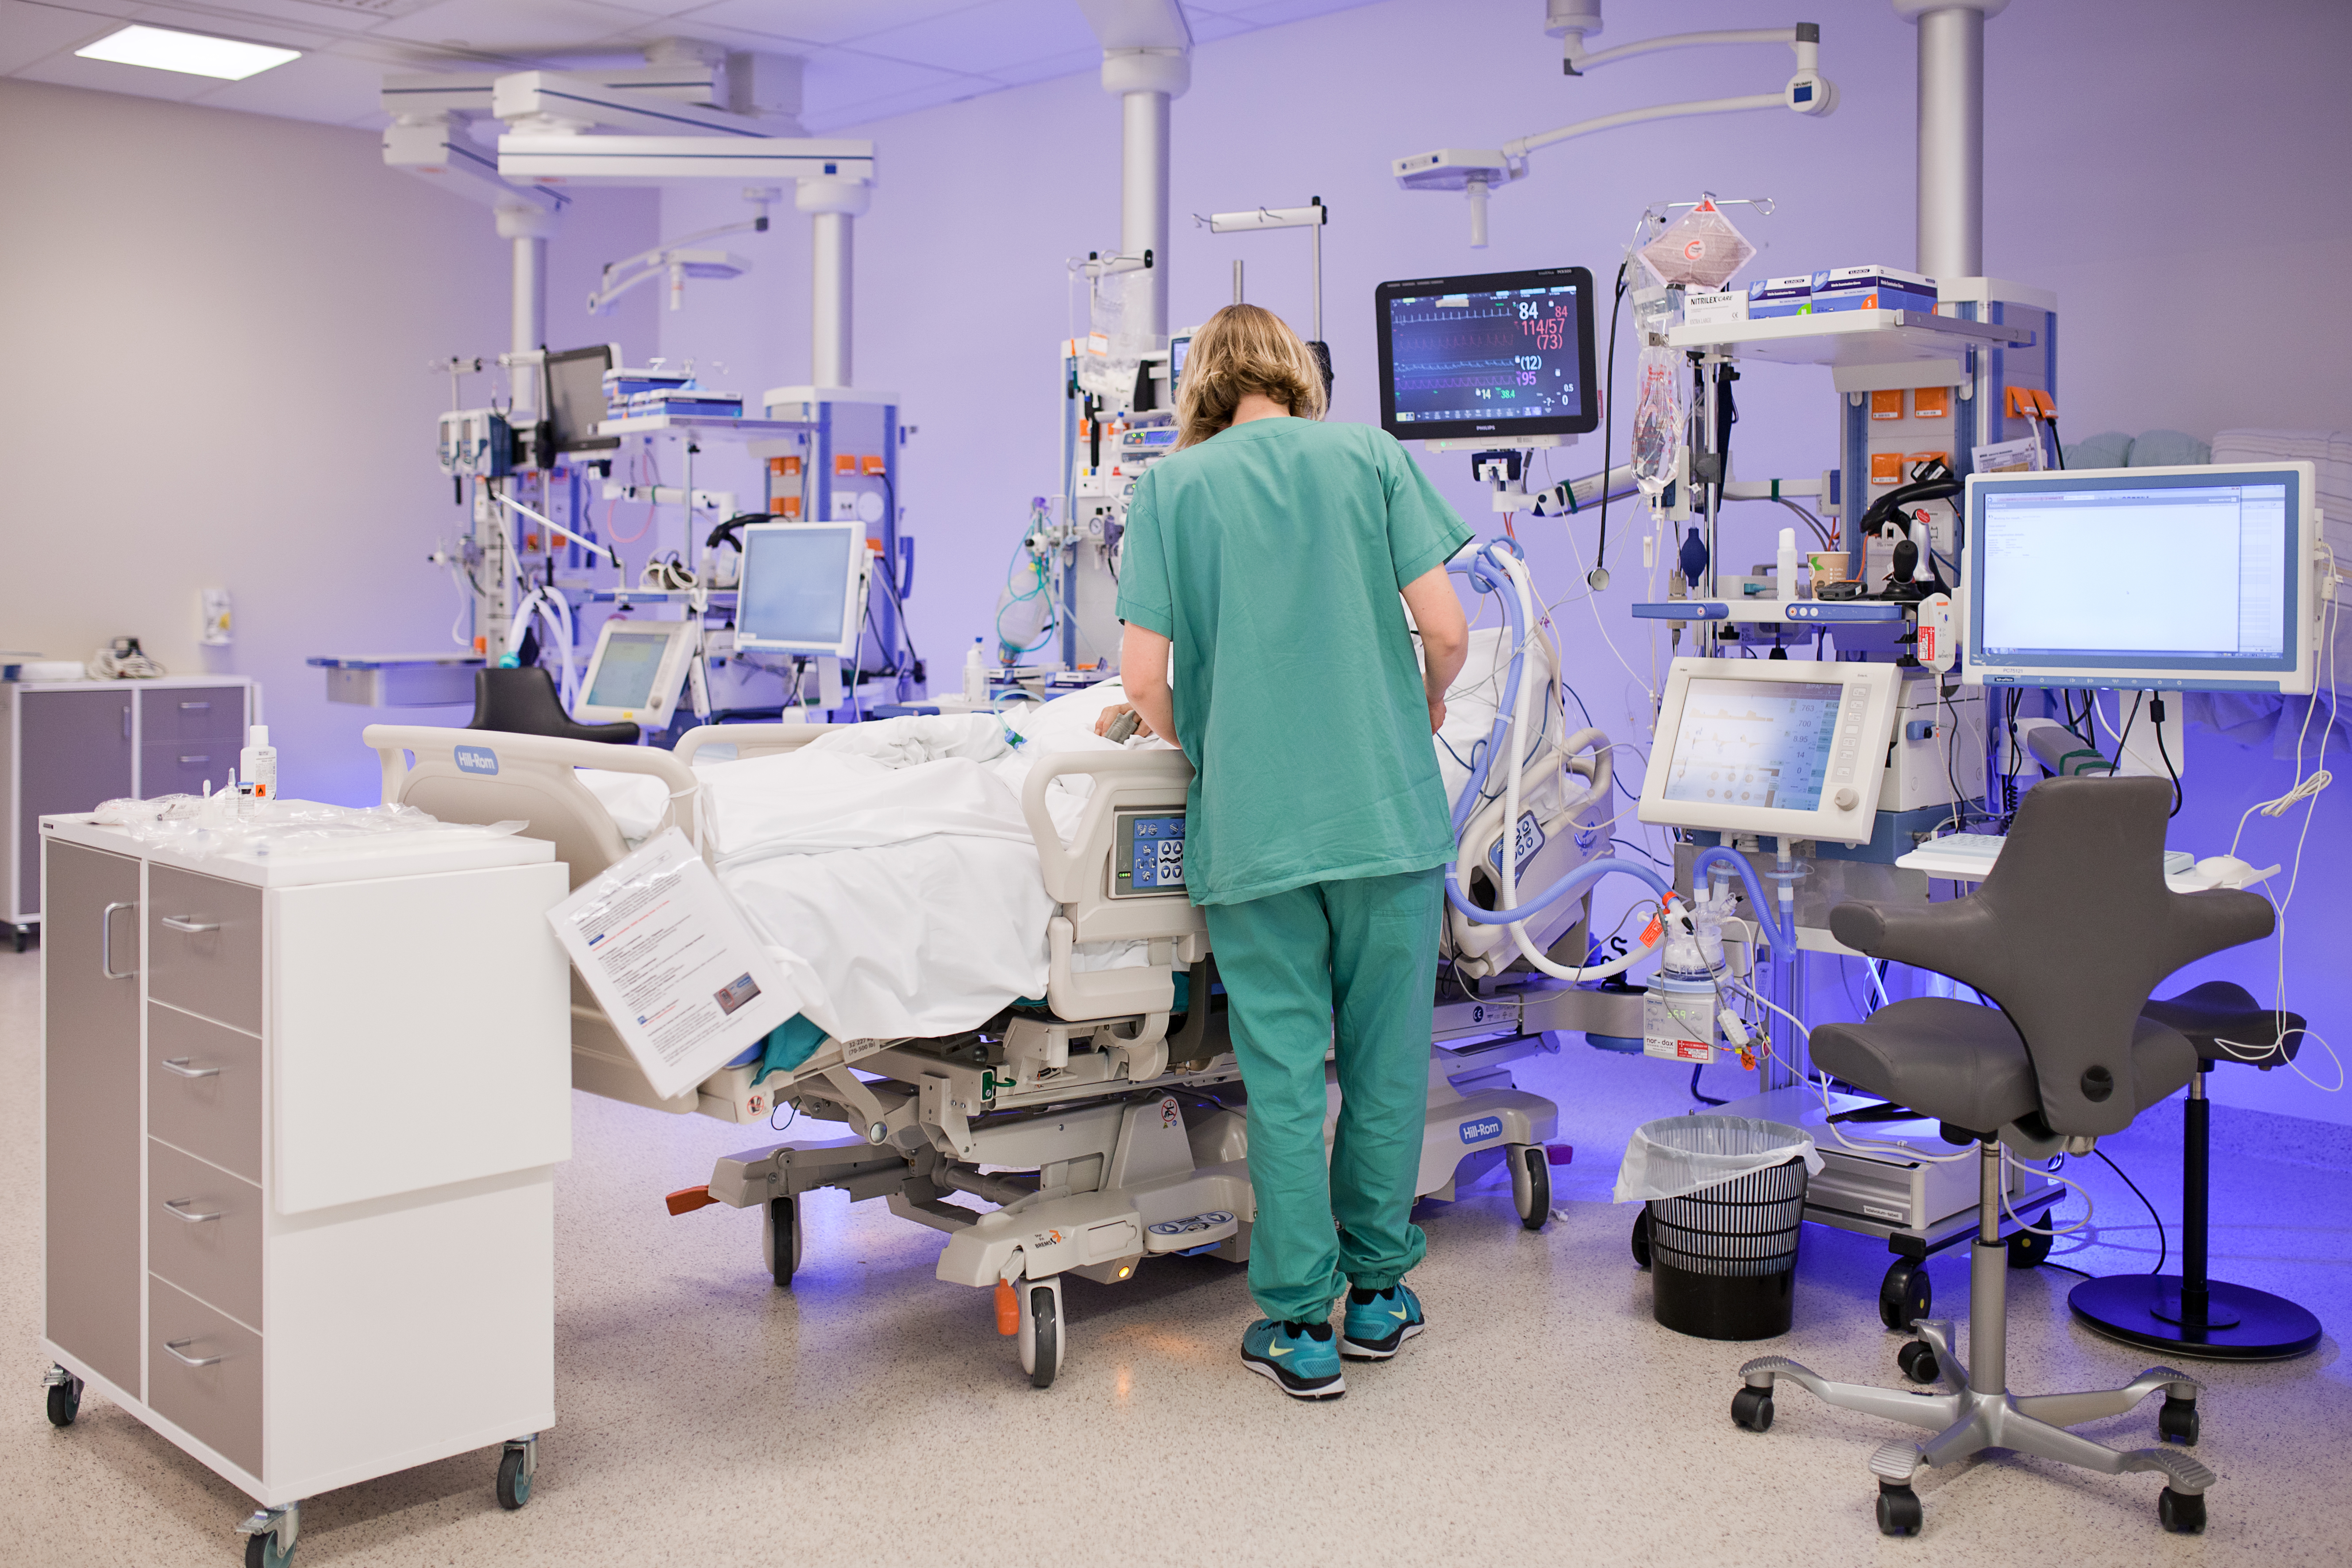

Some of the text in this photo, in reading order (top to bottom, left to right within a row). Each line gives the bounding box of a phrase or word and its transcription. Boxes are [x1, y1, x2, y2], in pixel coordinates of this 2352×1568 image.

[1691, 297, 1717, 305] NITRILEX
[1519, 301, 1568, 320] 84 84
[1521, 318, 1565, 336] 114/57
[1537, 334, 1563, 350] (73)
[1520, 355, 1542, 370] (12)
[1522, 370, 1536, 385] 95
[1563, 383, 1574, 392] 0.5
[1481, 389, 1515, 400] 14 38.4
[1562, 395, 1568, 406] 0
[458, 751, 496, 769] Hill-Rom
[1474, 1009, 1482, 1019] CE
[849, 1038, 866, 1048] 32-227
[849, 1045, 868, 1056] (70-500
[1463, 1123, 1499, 1140] Hill-Rom
